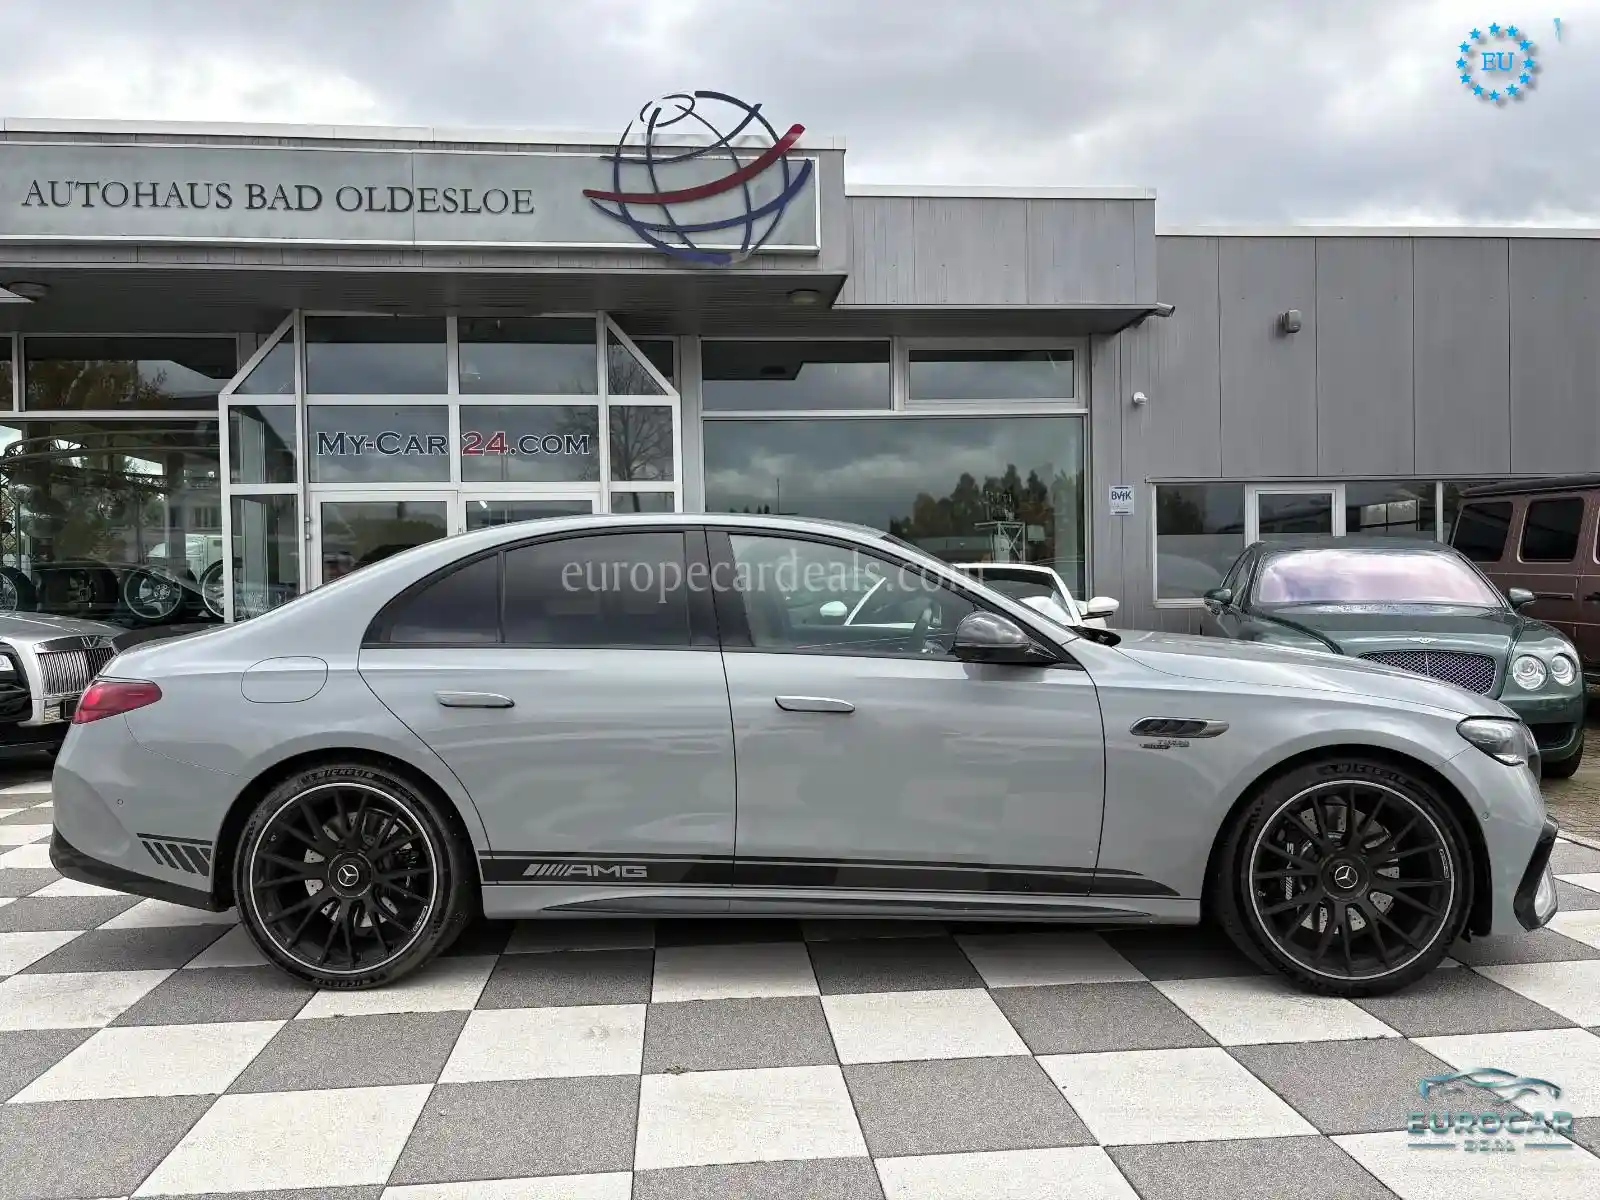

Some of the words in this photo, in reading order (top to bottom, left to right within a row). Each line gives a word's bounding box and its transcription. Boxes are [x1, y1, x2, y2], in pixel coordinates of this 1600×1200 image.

[22, 180, 233, 209] AUTOHAUS
[244, 183, 323, 212] BAD
[335, 185, 536, 215] OLDESLOE
[563, 863, 648, 878] AMG
